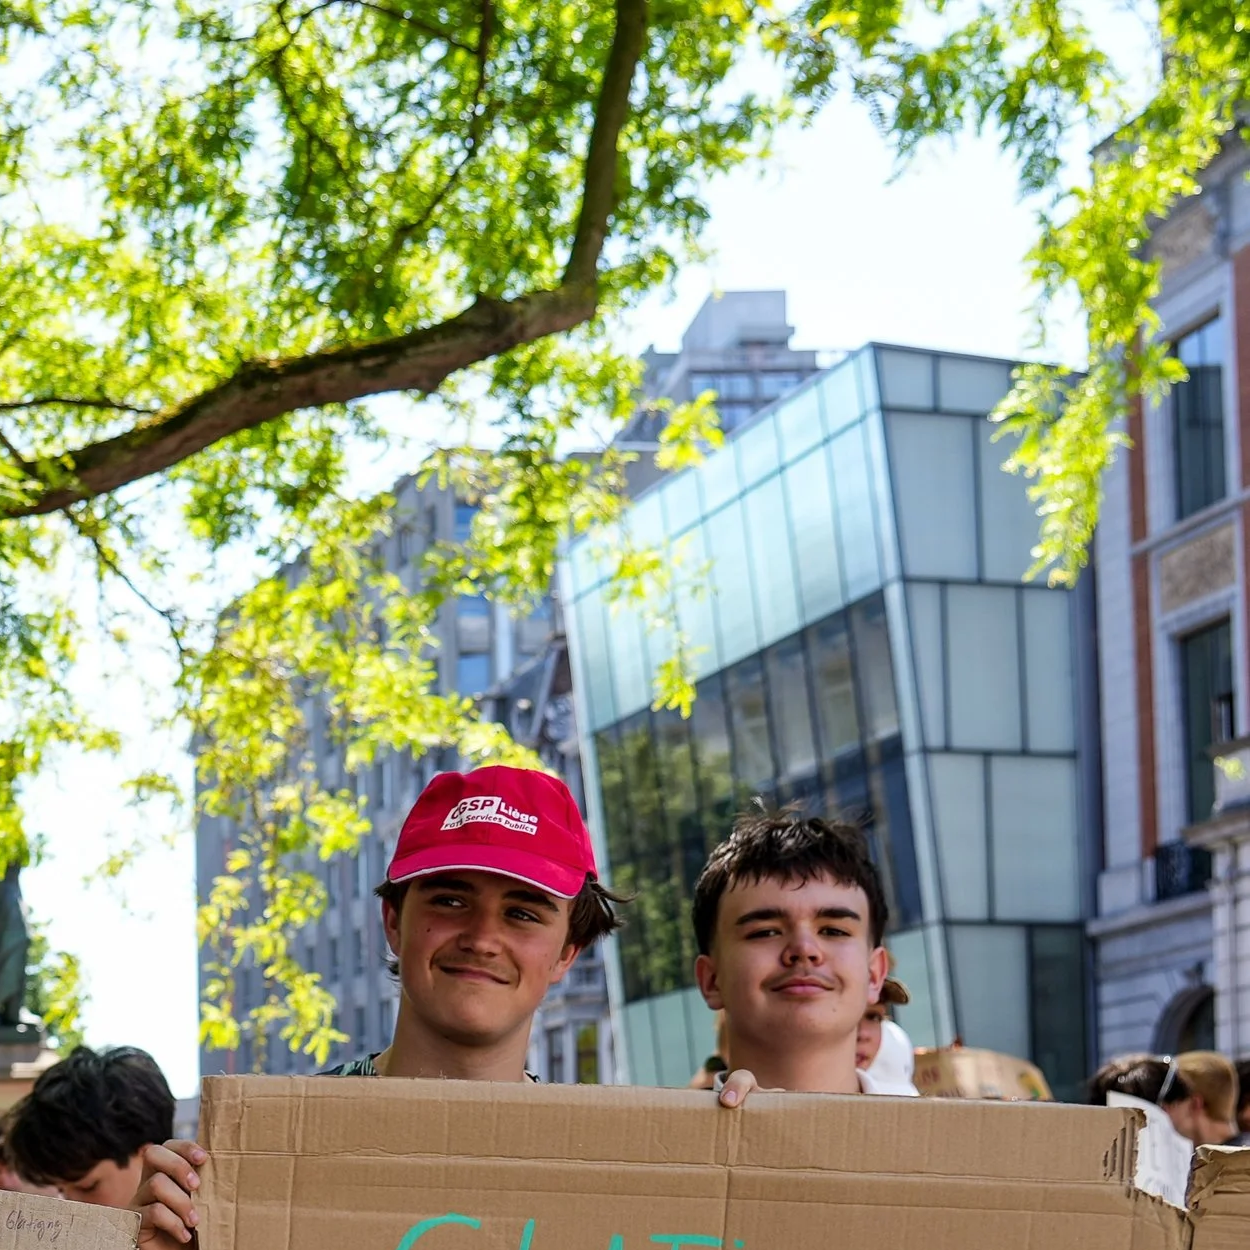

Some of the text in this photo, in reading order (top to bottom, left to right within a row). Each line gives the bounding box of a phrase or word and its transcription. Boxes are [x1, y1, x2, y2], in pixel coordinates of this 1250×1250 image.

[450, 799, 495, 820] CGSP
[499, 802, 539, 824] Liège
[465, 813, 502, 824] Services
[504, 820, 535, 834] Publics
